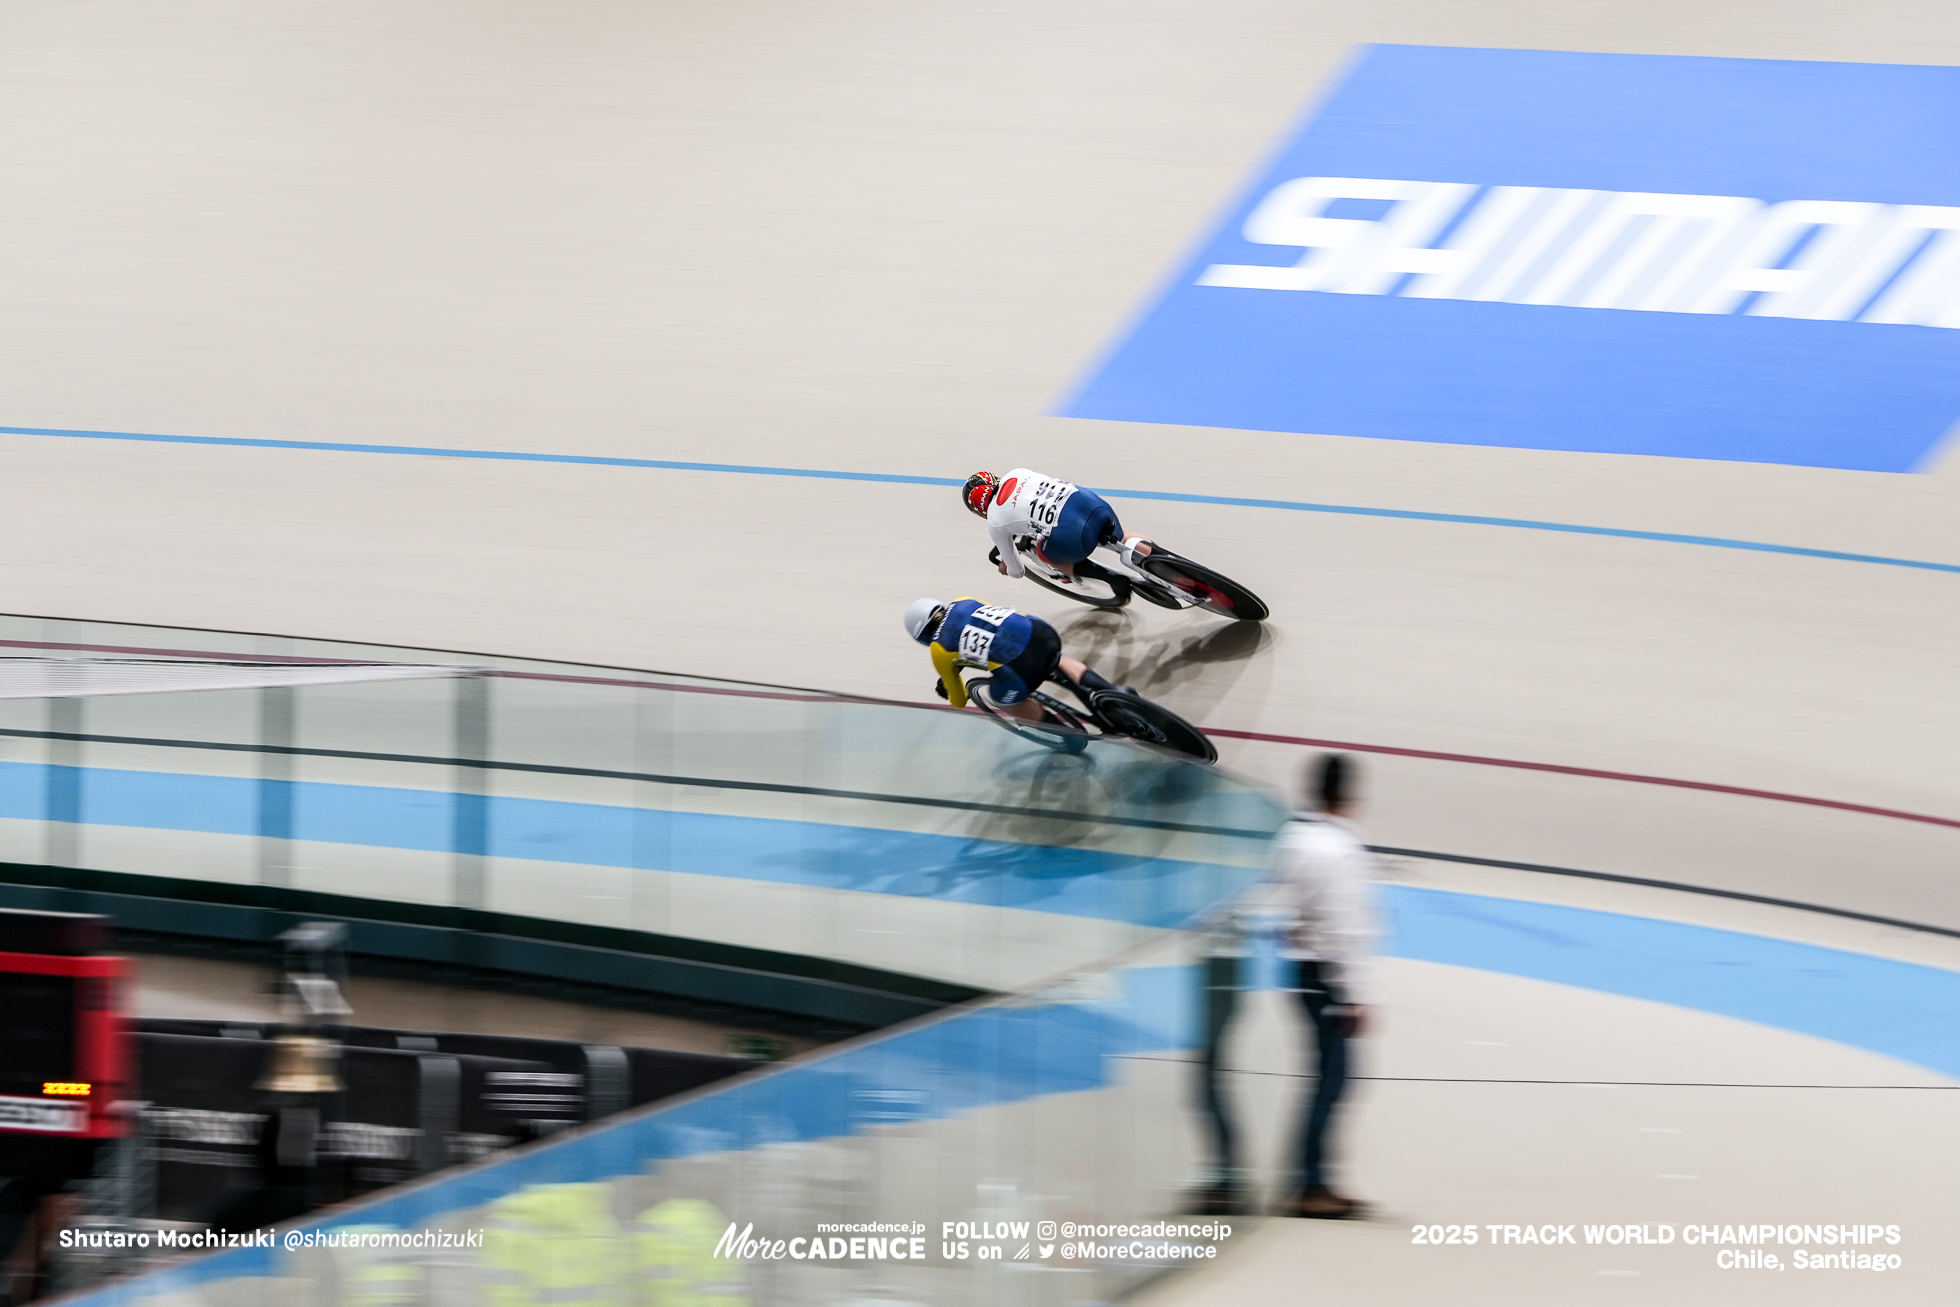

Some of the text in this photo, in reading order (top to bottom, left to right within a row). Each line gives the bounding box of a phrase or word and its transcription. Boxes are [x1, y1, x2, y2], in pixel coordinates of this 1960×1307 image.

[979, 486, 991, 509] JAPAN
[1029, 498, 1057, 525] 116
[961, 630, 990, 655] 137
